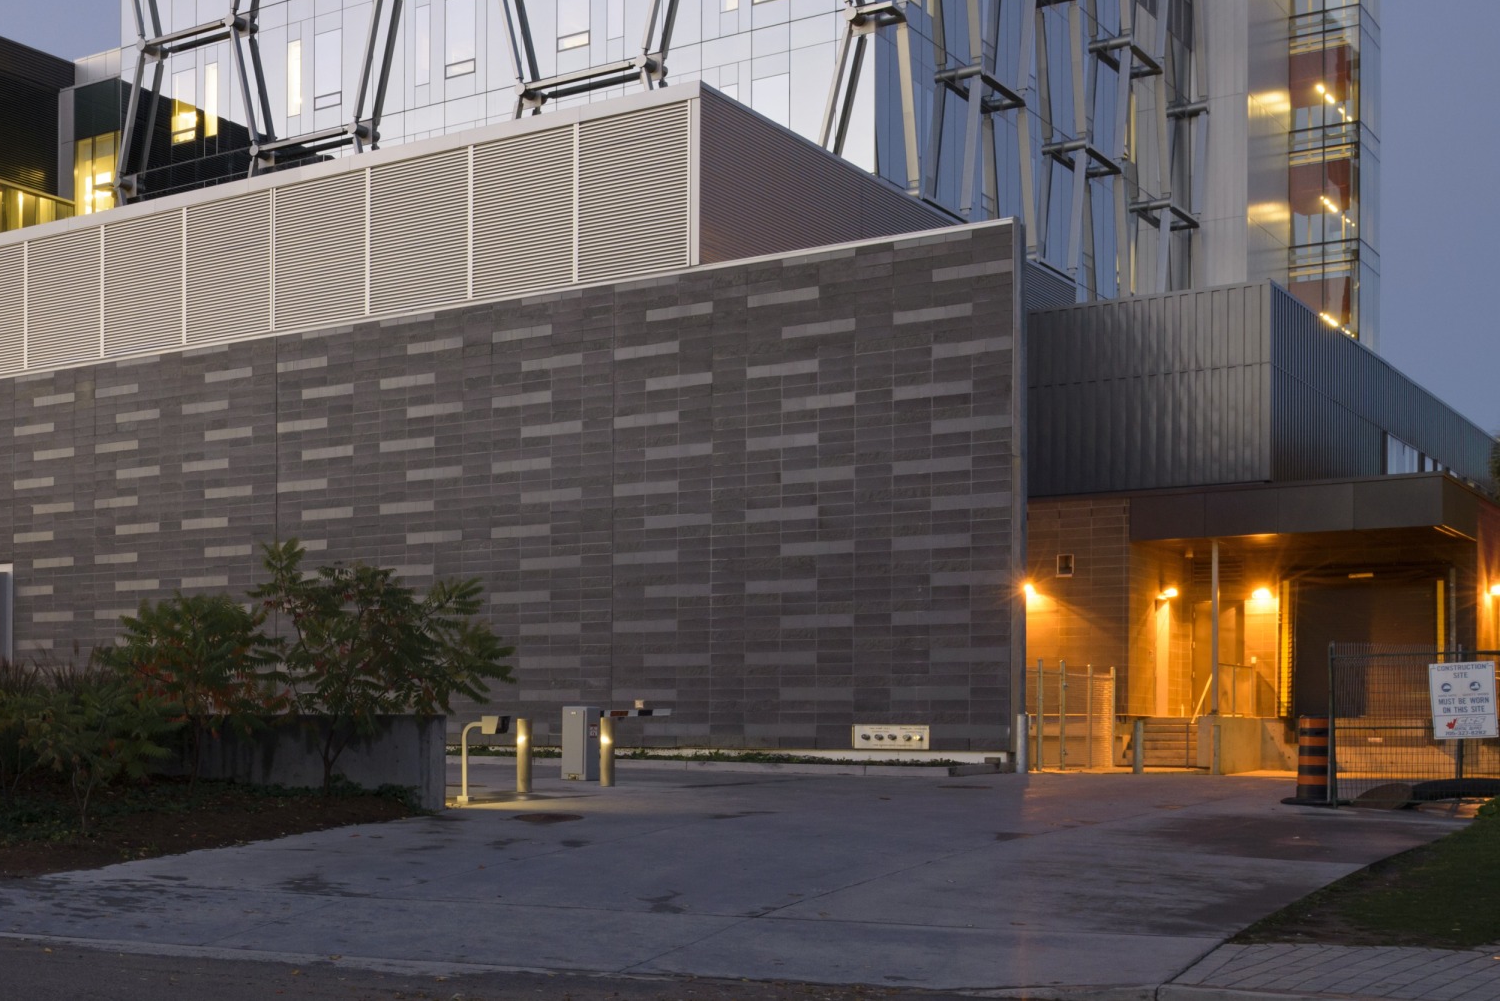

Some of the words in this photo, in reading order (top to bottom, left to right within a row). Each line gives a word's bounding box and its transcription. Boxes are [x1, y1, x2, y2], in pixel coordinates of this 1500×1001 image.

[1437, 663, 1487, 671] CONSTRUCTION
[1458, 697, 1467, 705] BE
[1471, 705, 1485, 713] SITE
